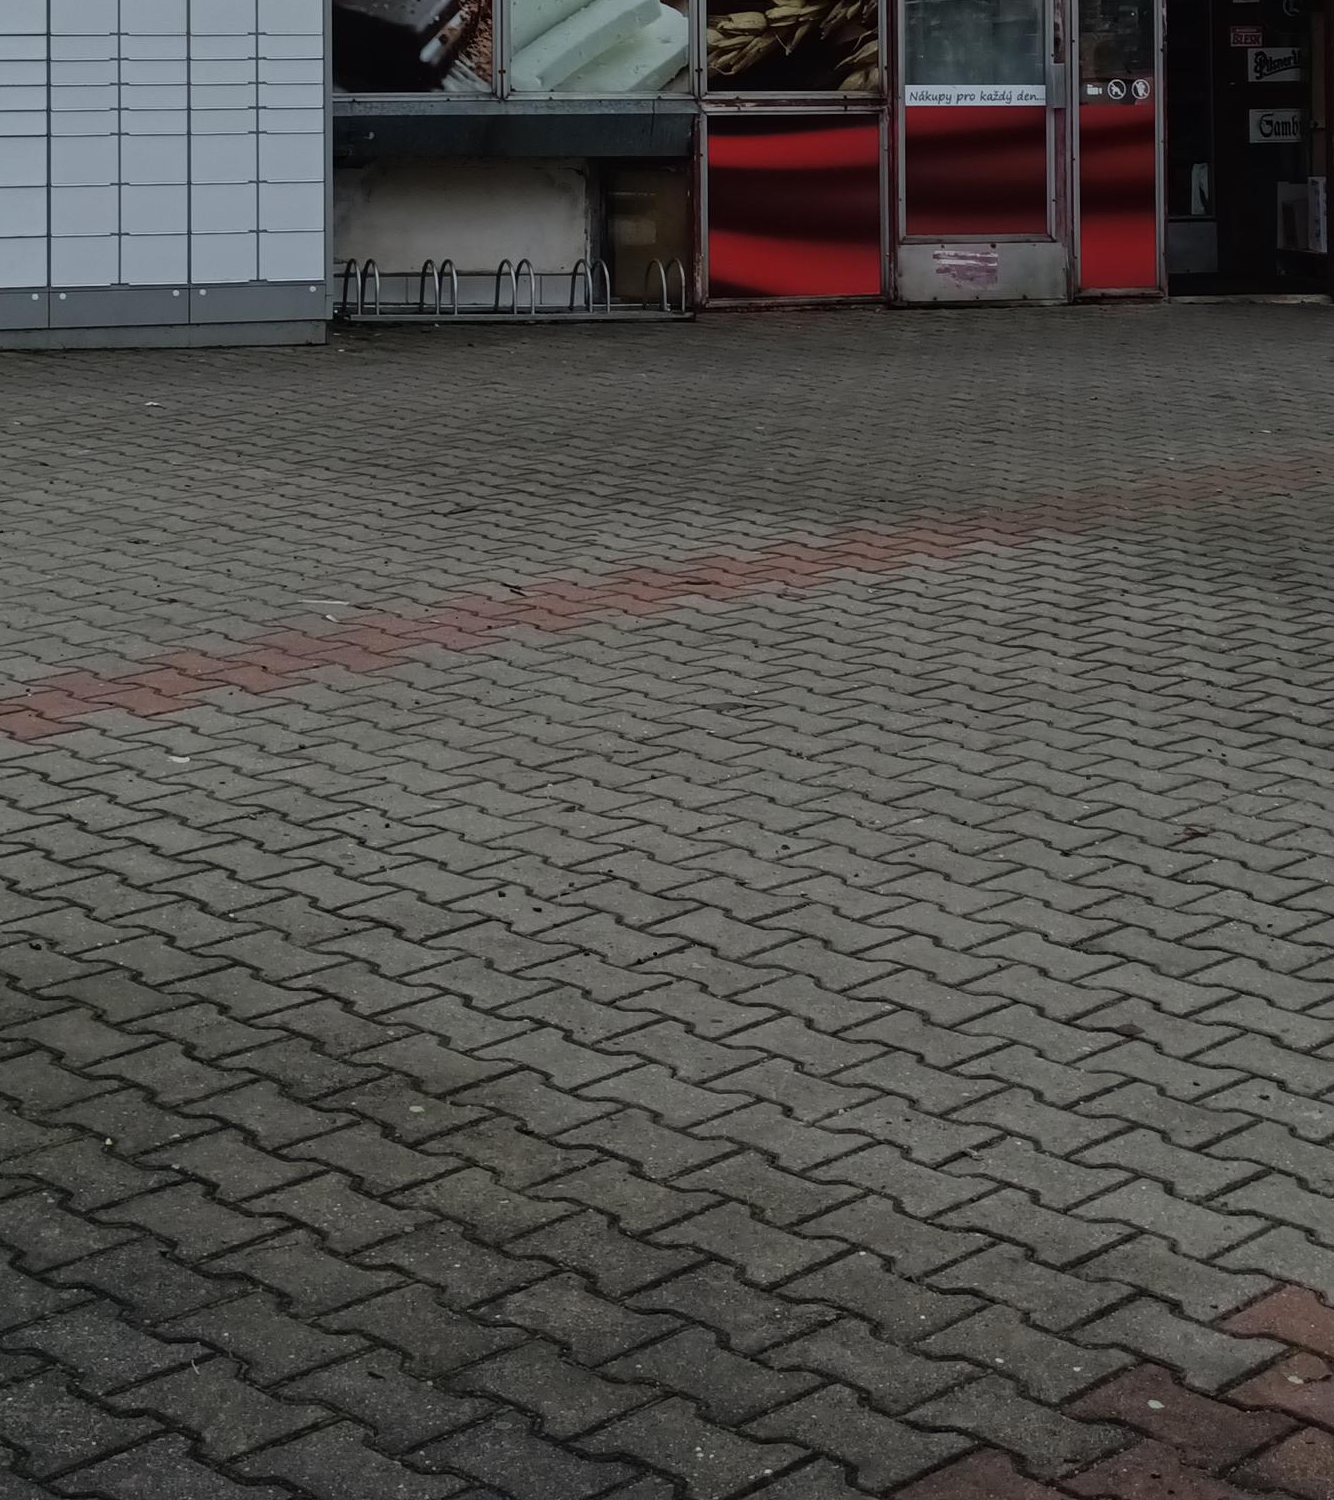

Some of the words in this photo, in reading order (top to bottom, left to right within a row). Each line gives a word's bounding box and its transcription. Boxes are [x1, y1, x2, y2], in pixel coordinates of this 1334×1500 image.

[909, 90, 952, 105] Nákupy
[957, 92, 976, 106] pro
[981, 90, 1012, 106] každý
